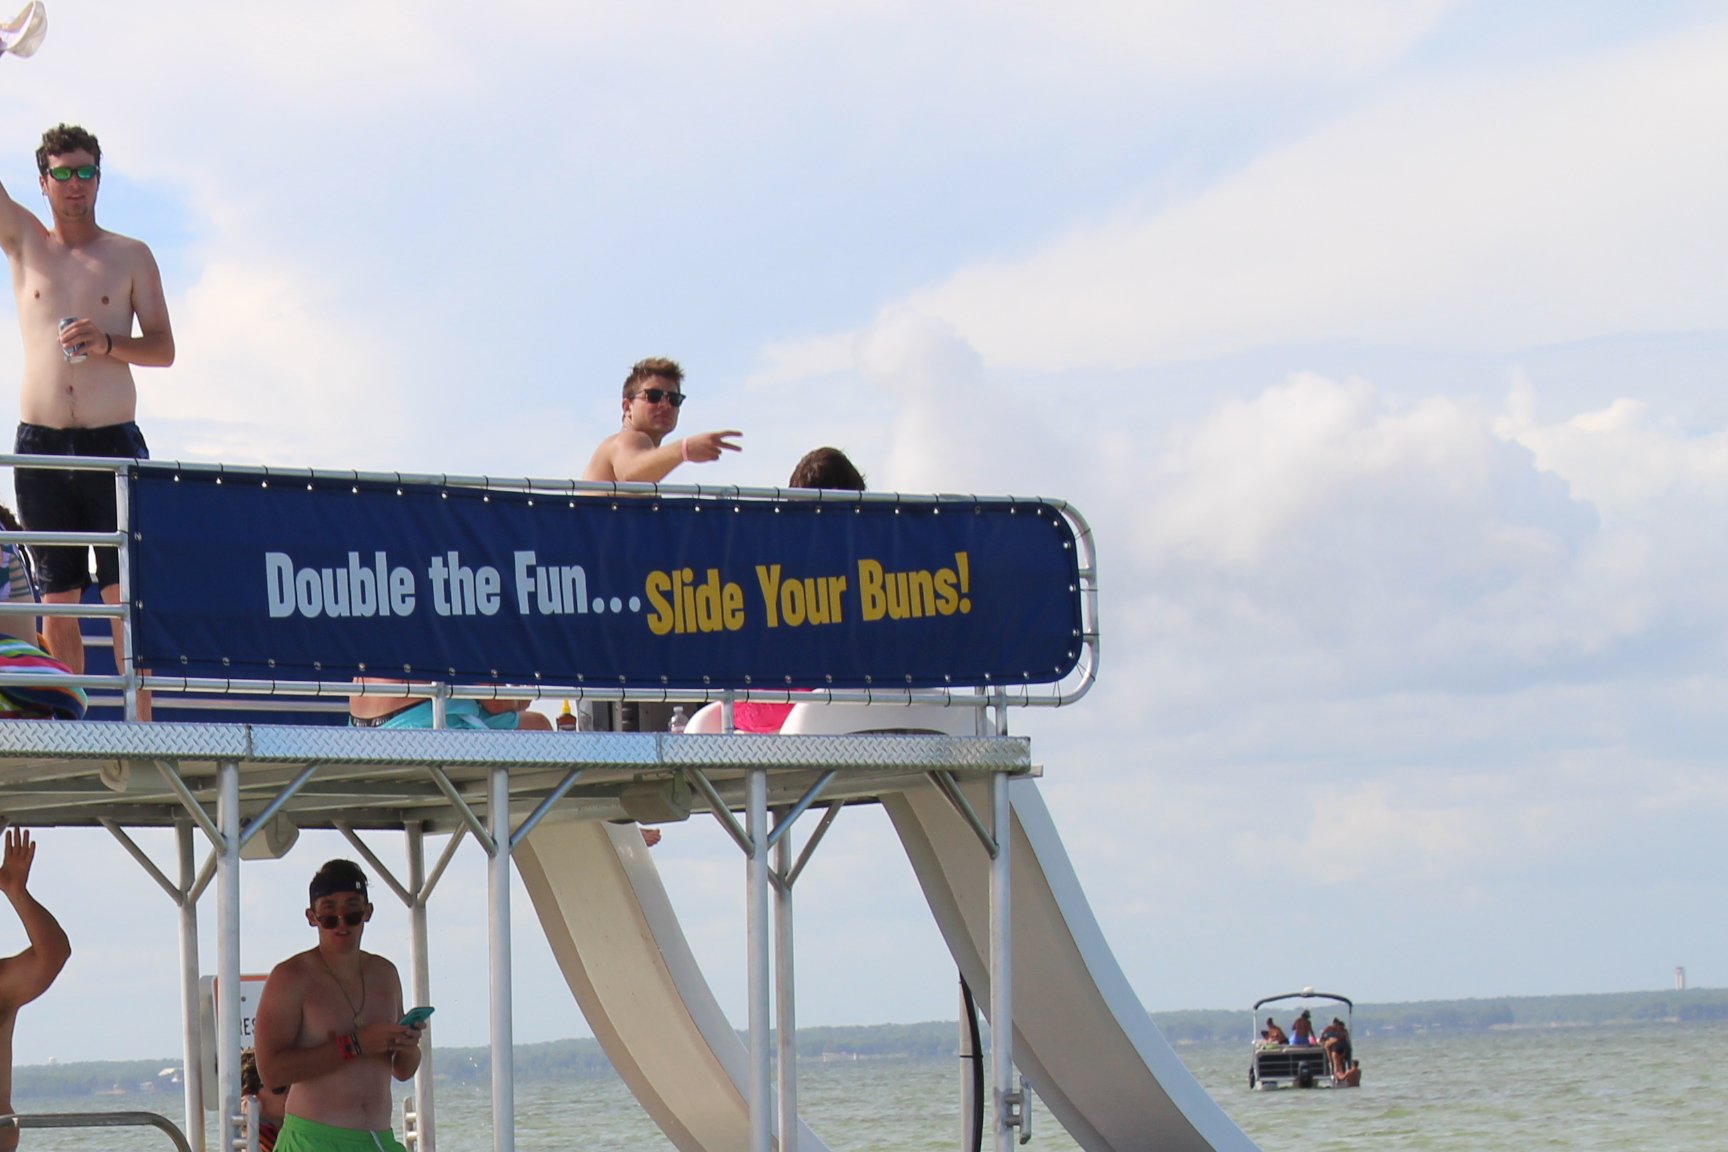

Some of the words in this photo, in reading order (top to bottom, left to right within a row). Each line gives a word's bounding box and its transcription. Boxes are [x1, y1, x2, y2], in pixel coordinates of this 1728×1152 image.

[265, 551, 416, 618] Double
[428, 550, 501, 616] the
[645, 565, 745, 635] Slide
[755, 564, 847, 628] Your
[858, 551, 972, 622] Buns!
